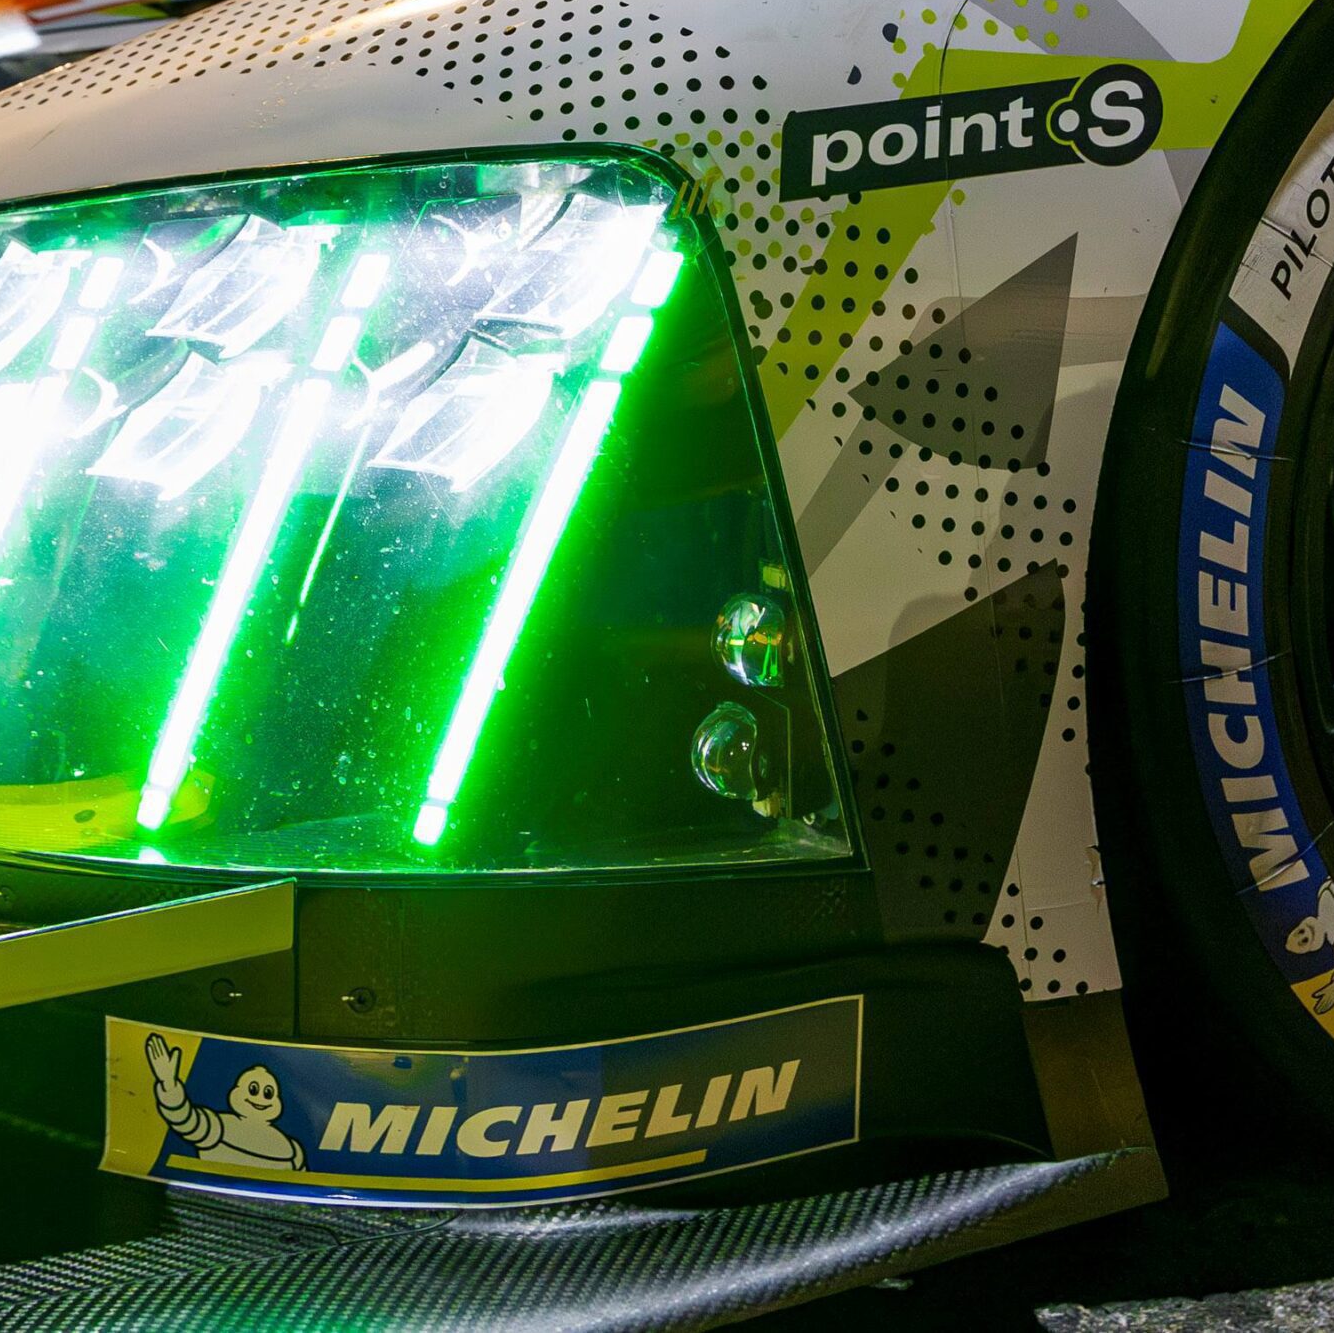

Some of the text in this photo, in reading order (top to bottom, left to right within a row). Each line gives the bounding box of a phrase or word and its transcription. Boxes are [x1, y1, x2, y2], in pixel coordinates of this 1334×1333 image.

[811, 96, 1035, 187] point
[1198, 382, 1312, 893] MICHELIN
[317, 1059, 801, 1158] MICHELIN
